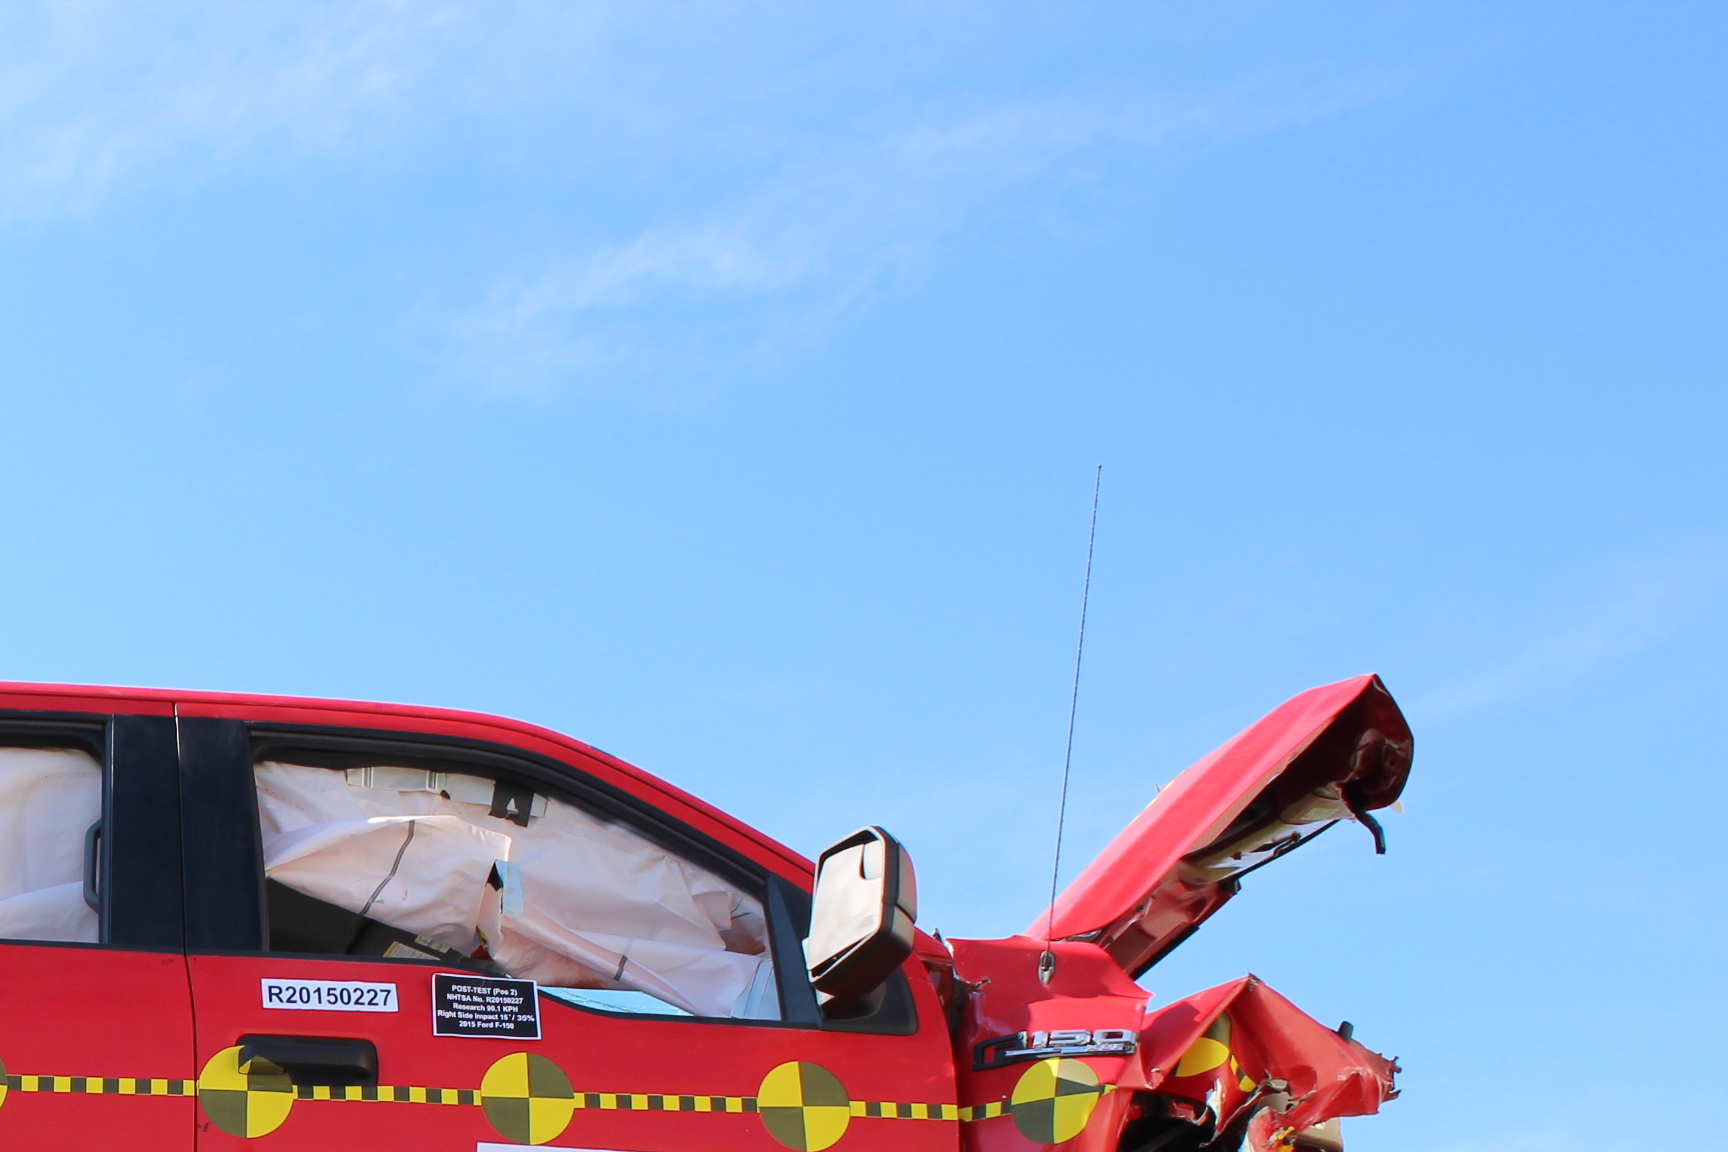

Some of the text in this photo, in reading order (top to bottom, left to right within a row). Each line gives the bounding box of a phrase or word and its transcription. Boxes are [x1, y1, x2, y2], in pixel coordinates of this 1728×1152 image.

[267, 985, 392, 1007] R20150227
[451, 985, 518, 997] POST-TEST (Pos 2)
[446, 993, 524, 1005] NHTSA No. R20150227
[452, 1002, 486, 1012] Research
[502, 1005, 519, 1013] KPH
[437, 1010, 456, 1019] Right
[457, 1011, 473, 1019] Side
[474, 1012, 499, 1021] Impact
[516, 1014, 535, 1022] 35%
[476, 1021, 494, 1029] Ford
[494, 1022, 515, 1030] F-150
